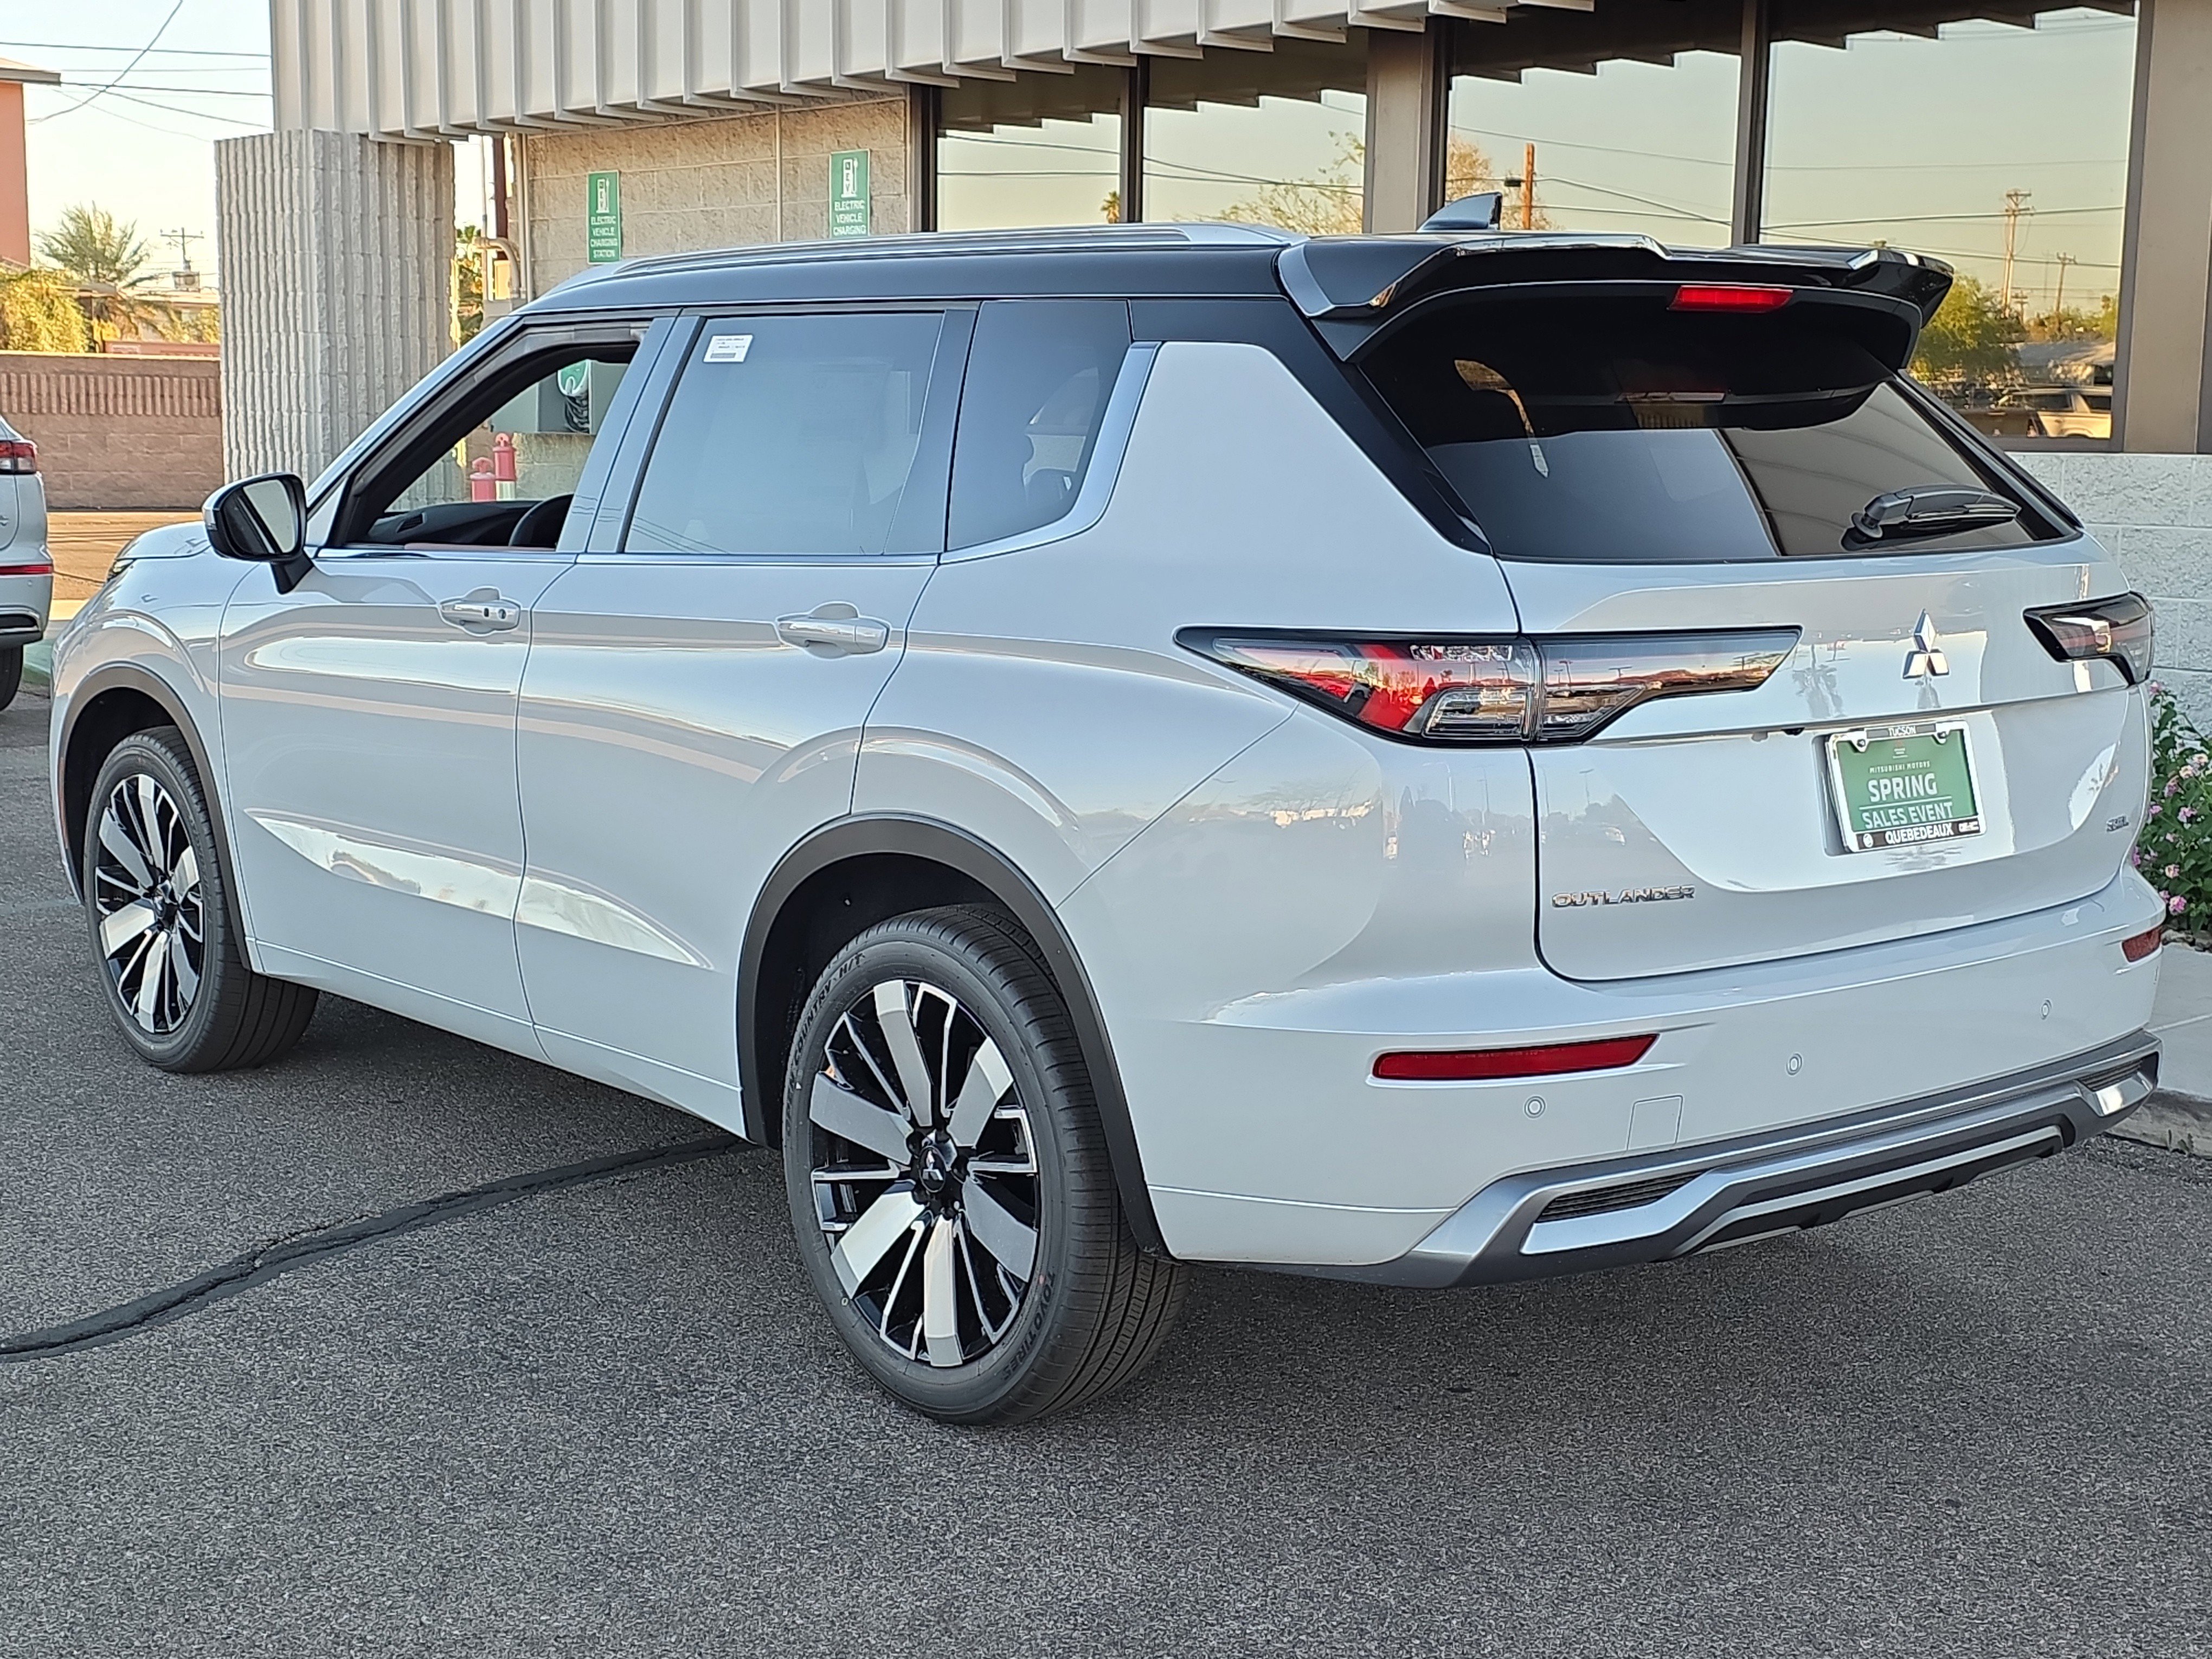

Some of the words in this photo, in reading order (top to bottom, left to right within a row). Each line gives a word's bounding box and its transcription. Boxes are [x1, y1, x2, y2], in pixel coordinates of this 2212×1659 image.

[834, 200, 865, 211] ELECTRIC
[590, 216, 616, 225] ELECTRIC
[836, 213, 863, 223] VEHICLE
[592, 227, 615, 236] VEHICLE
[833, 224, 866, 236] CHARGING
[590, 238, 618, 247] CHARGING
[593, 249, 615, 258] STATION
[1888, 725, 1917, 736] TUCSON
[1869, 763, 1905, 774] MITSUBISHI
[1907, 760, 1930, 769] MOTORS
[1868, 773, 1938, 802] SPRING
[1862, 807, 1907, 829] SALES
[1908, 801, 1953, 824] EVENT
[1885, 822, 1954, 845] QUEBEDEAUX
[1552, 885, 1696, 908] OUTLANDER
[794, 979, 832, 1066] COUNTRY
[1034, 1270, 1056, 1330] TOYO
[1004, 1330, 1037, 1381] TIRES
